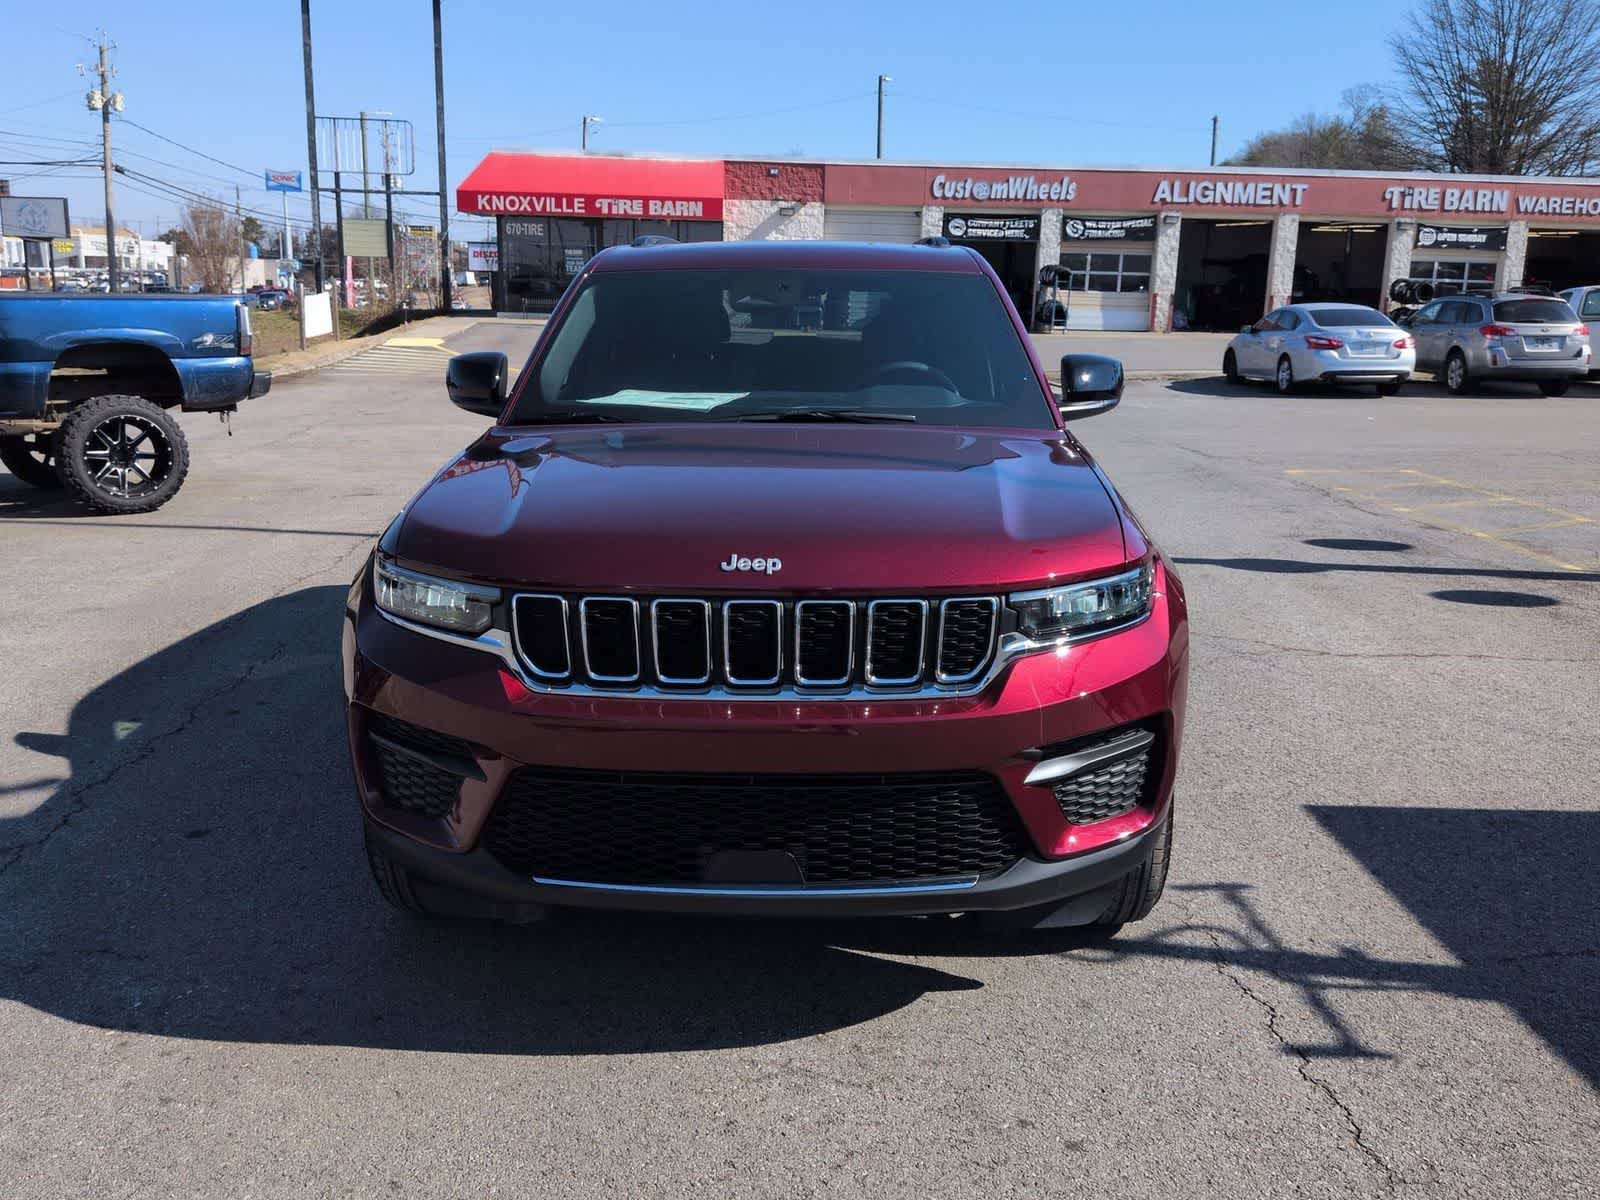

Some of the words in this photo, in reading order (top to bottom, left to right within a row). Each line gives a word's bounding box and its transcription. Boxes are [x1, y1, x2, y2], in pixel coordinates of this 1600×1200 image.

[1153, 180, 1310, 206] ALIGNMENT
[1444, 189, 1509, 213] BARN
[477, 194, 586, 213] KNOXVILLE
[648, 200, 703, 217] BARN
[505, 223, 545, 236] 670-TIRE
[720, 553, 782, 575] Jeep
